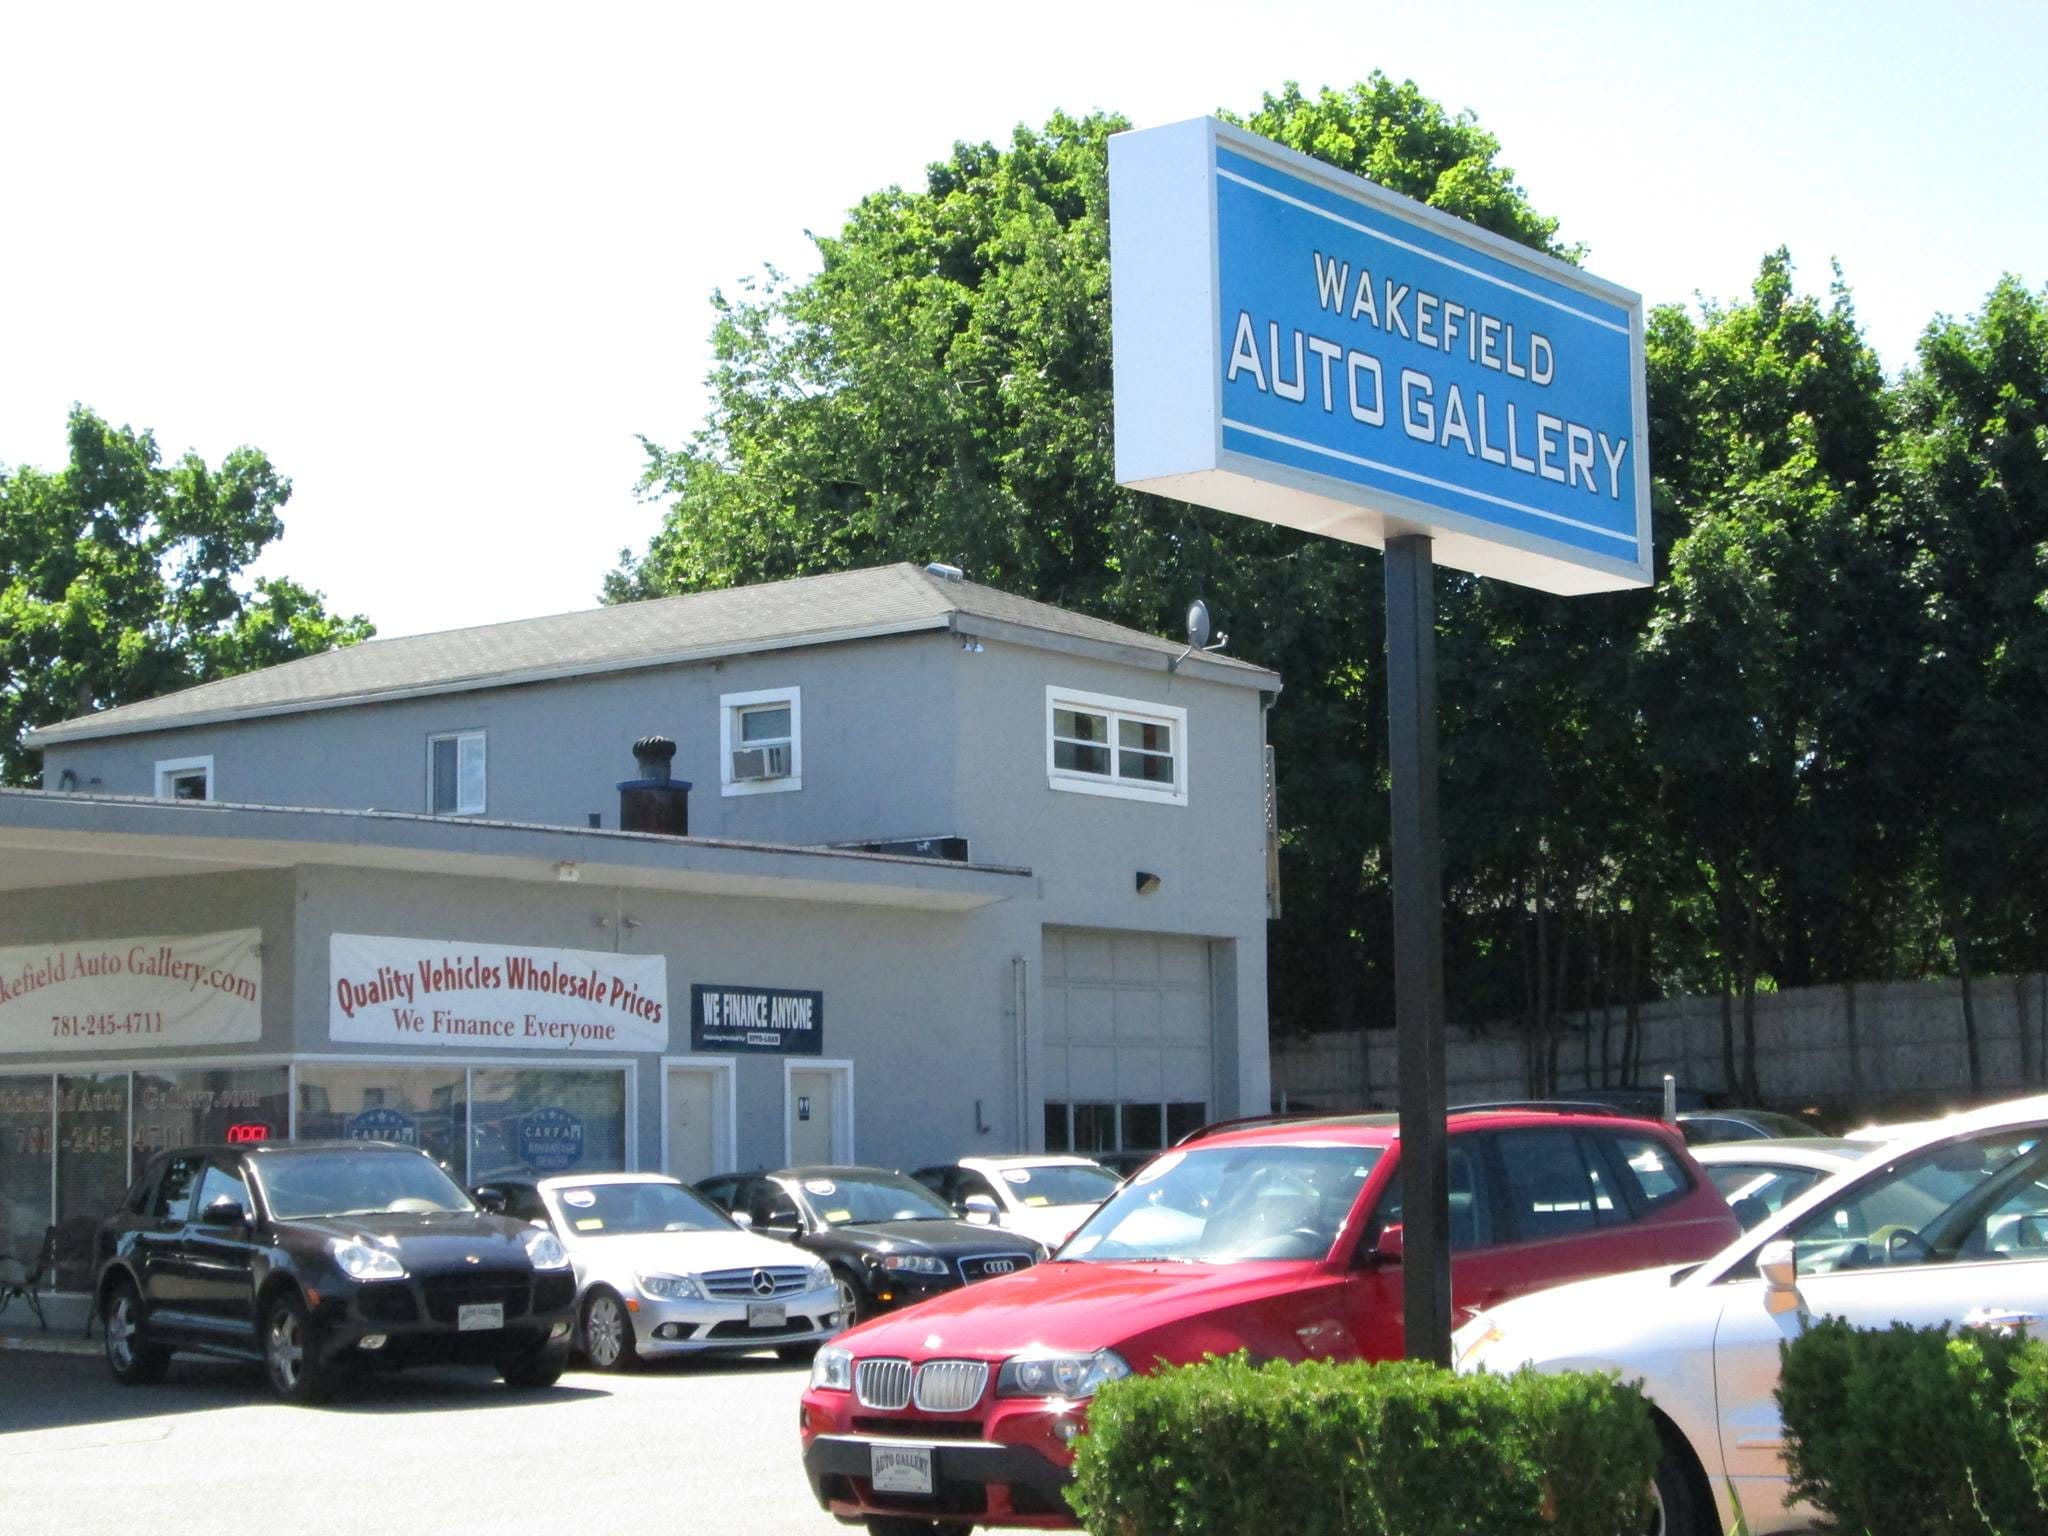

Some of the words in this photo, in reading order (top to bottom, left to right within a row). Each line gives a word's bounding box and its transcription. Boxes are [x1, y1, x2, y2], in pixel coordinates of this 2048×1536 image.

[1313, 250, 1555, 387] WAKEFIELD
[1226, 310, 1385, 428] AUTO
[1400, 367, 1629, 500] GALLERY
[71, 951, 121, 980] Auto
[127, 946, 257, 1002] Gallery.com
[337, 966, 414, 1018] Quality
[418, 956, 500, 994] Vehicles
[506, 956, 607, 1004] Wholesale
[609, 977, 663, 1025] Prices
[52, 1012, 163, 1037] 781-245-4711
[392, 1008, 424, 1033] We
[432, 1010, 515, 1037] Finance
[523, 1014, 616, 1047] Everyone
[703, 993, 720, 1026] WE
[723, 993, 768, 1028] FINANCE
[771, 996, 813, 1030] ANYONE
